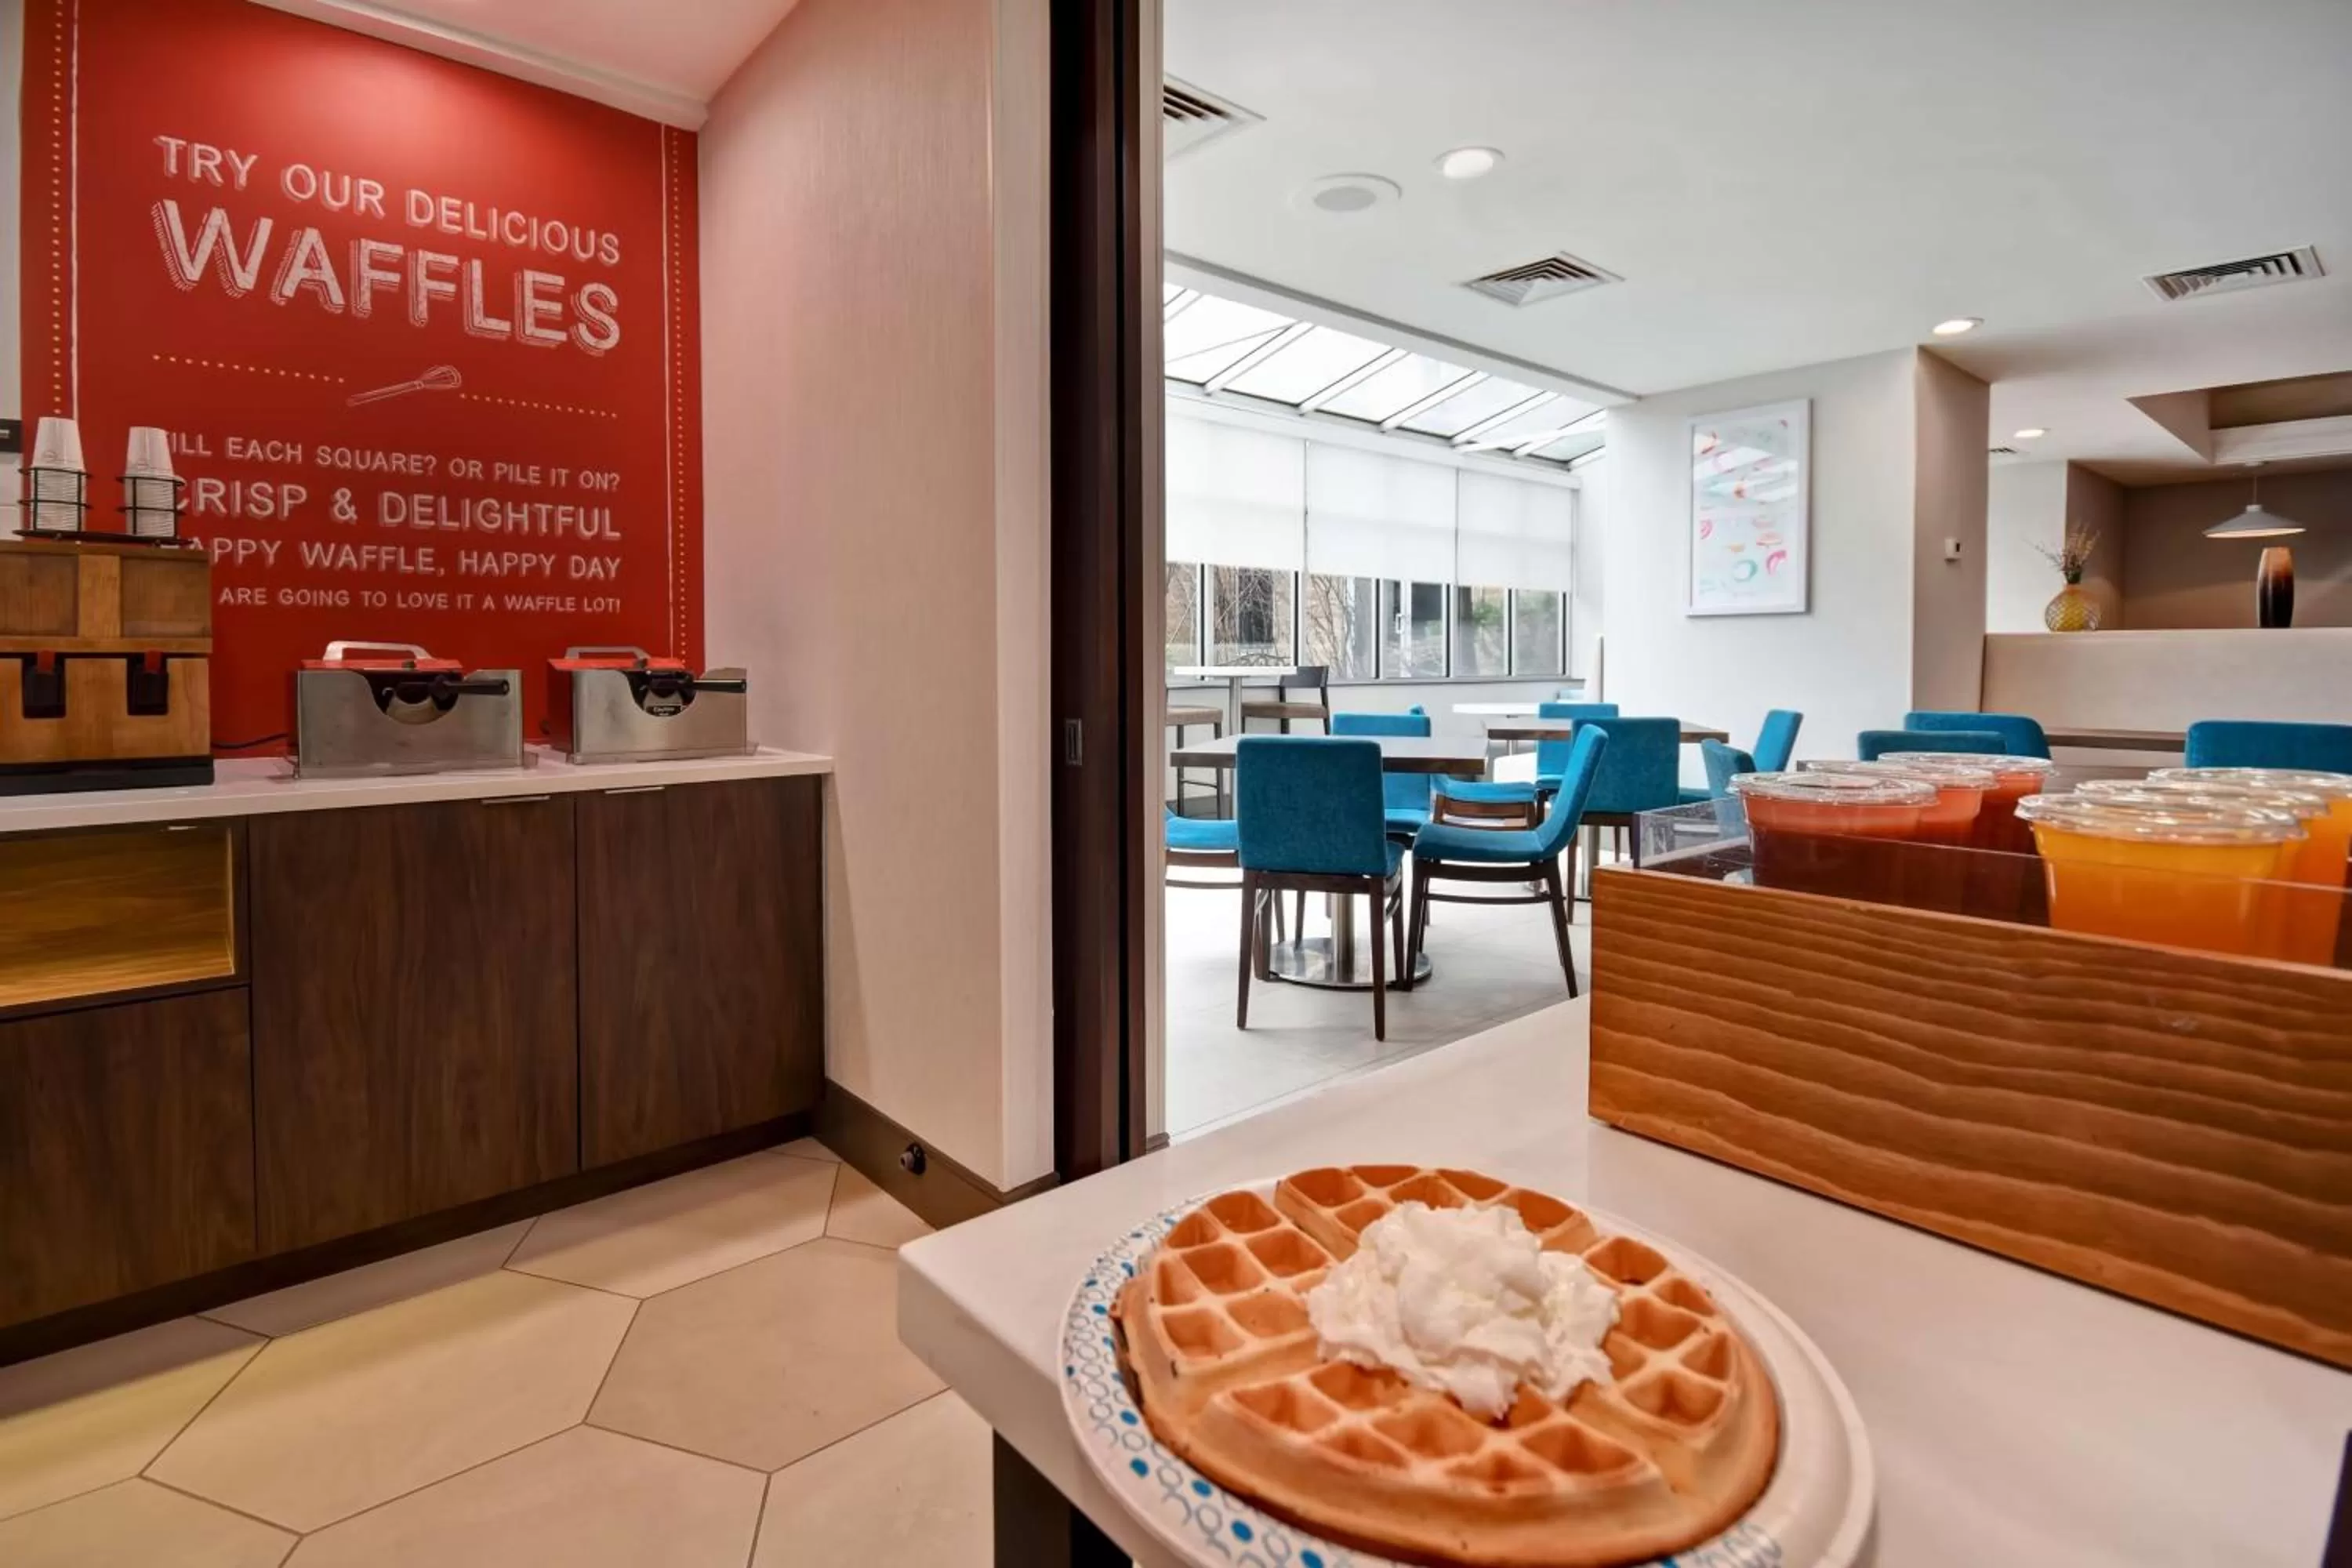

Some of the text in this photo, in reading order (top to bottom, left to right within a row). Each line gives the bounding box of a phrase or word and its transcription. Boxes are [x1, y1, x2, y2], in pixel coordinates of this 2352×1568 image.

[154, 135, 621, 267] TRY OUR DELICIOUS
[151, 198, 621, 357] WAFFLES
[166, 431, 621, 492] ILL EACH SQUARE? OR PILE IT ON?
[329, 487, 358, 524] &
[379, 491, 622, 541] DELIGHTFUL
[160, 535, 621, 581] PPY WAFFLE, HAPPY DAY
[218, 586, 268, 606] ARE
[278, 588, 350, 608] GOING
[360, 590, 387, 608] TO
[396, 590, 449, 610] LOVE
[457, 593, 474, 610] IT
[481, 593, 496, 612] A
[503, 594, 578, 612] WAFFLE
